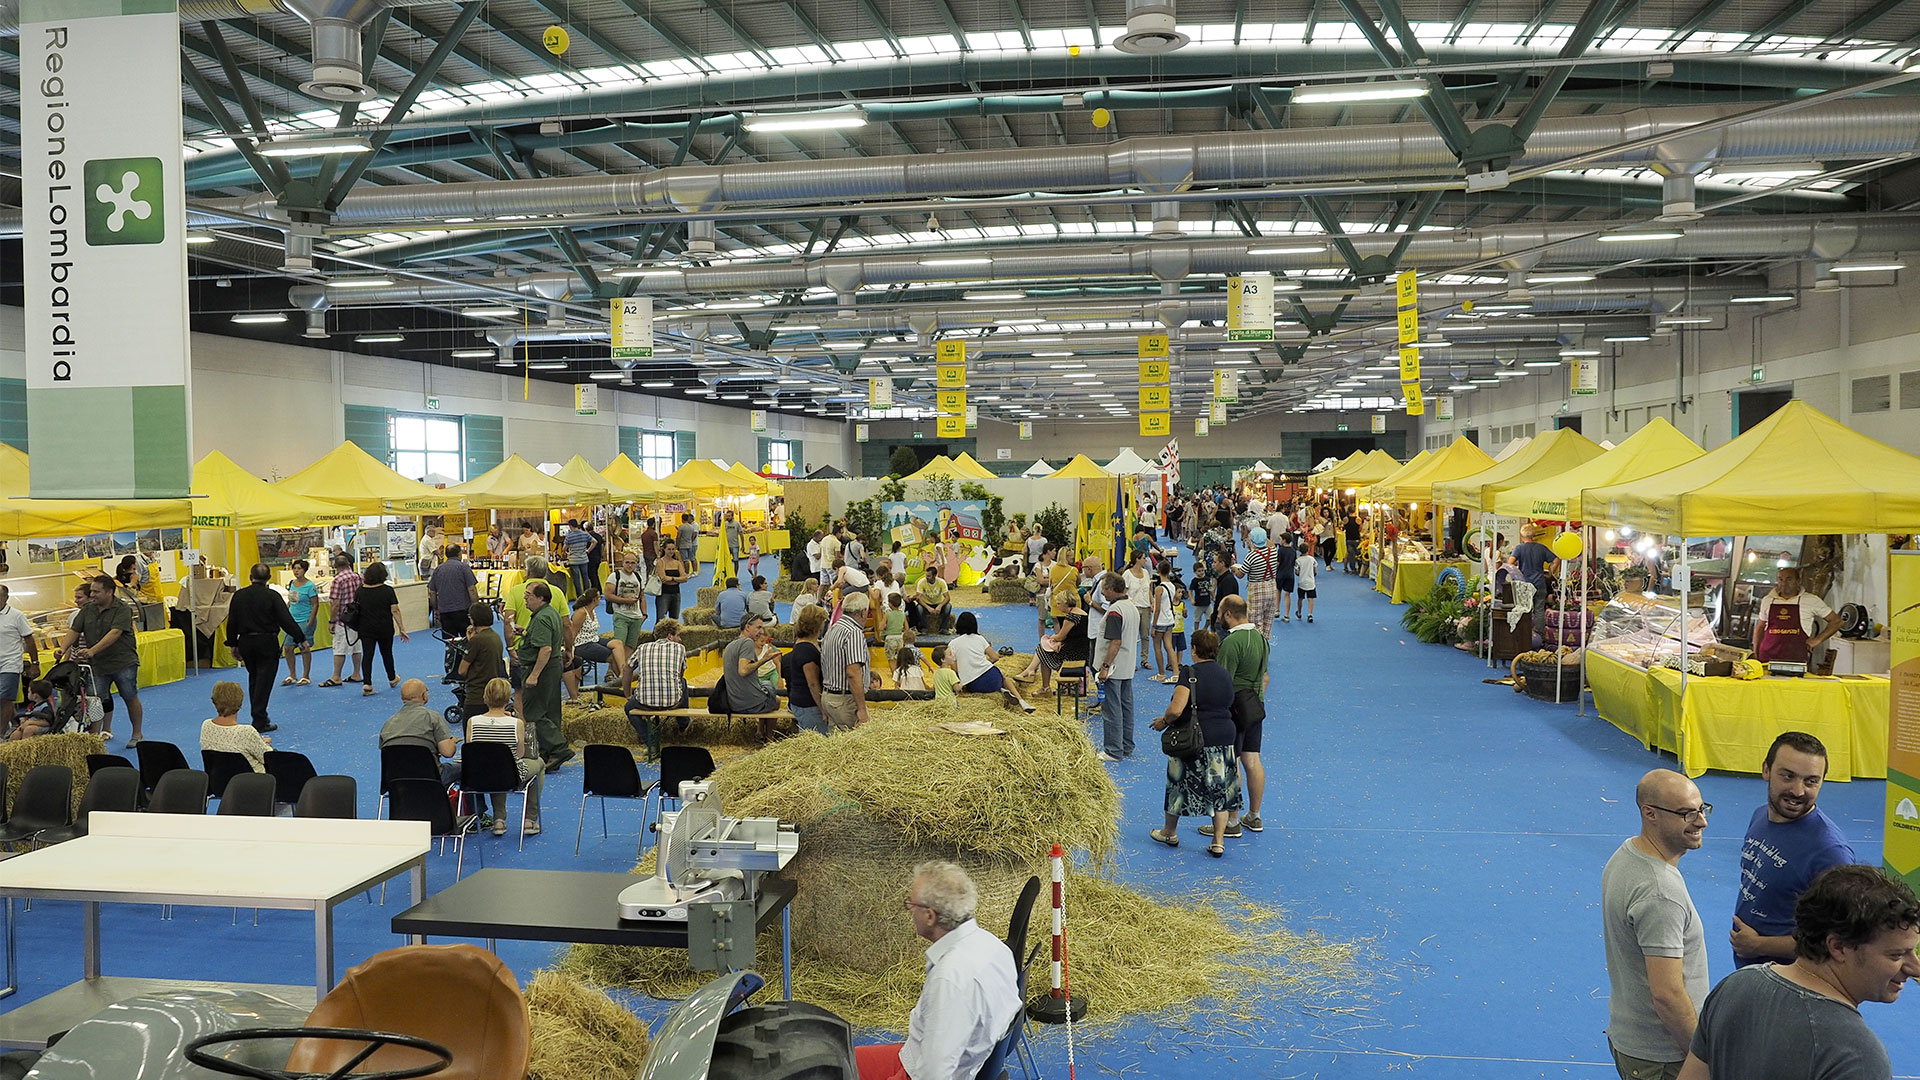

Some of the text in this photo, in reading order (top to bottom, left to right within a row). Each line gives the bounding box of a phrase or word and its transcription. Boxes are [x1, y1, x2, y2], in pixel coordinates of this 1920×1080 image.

[1243, 285, 1258, 294] A3
[624, 305, 637, 315] A2
[188, 553, 195, 561] 20
[1679, 572, 1683, 582] 1
